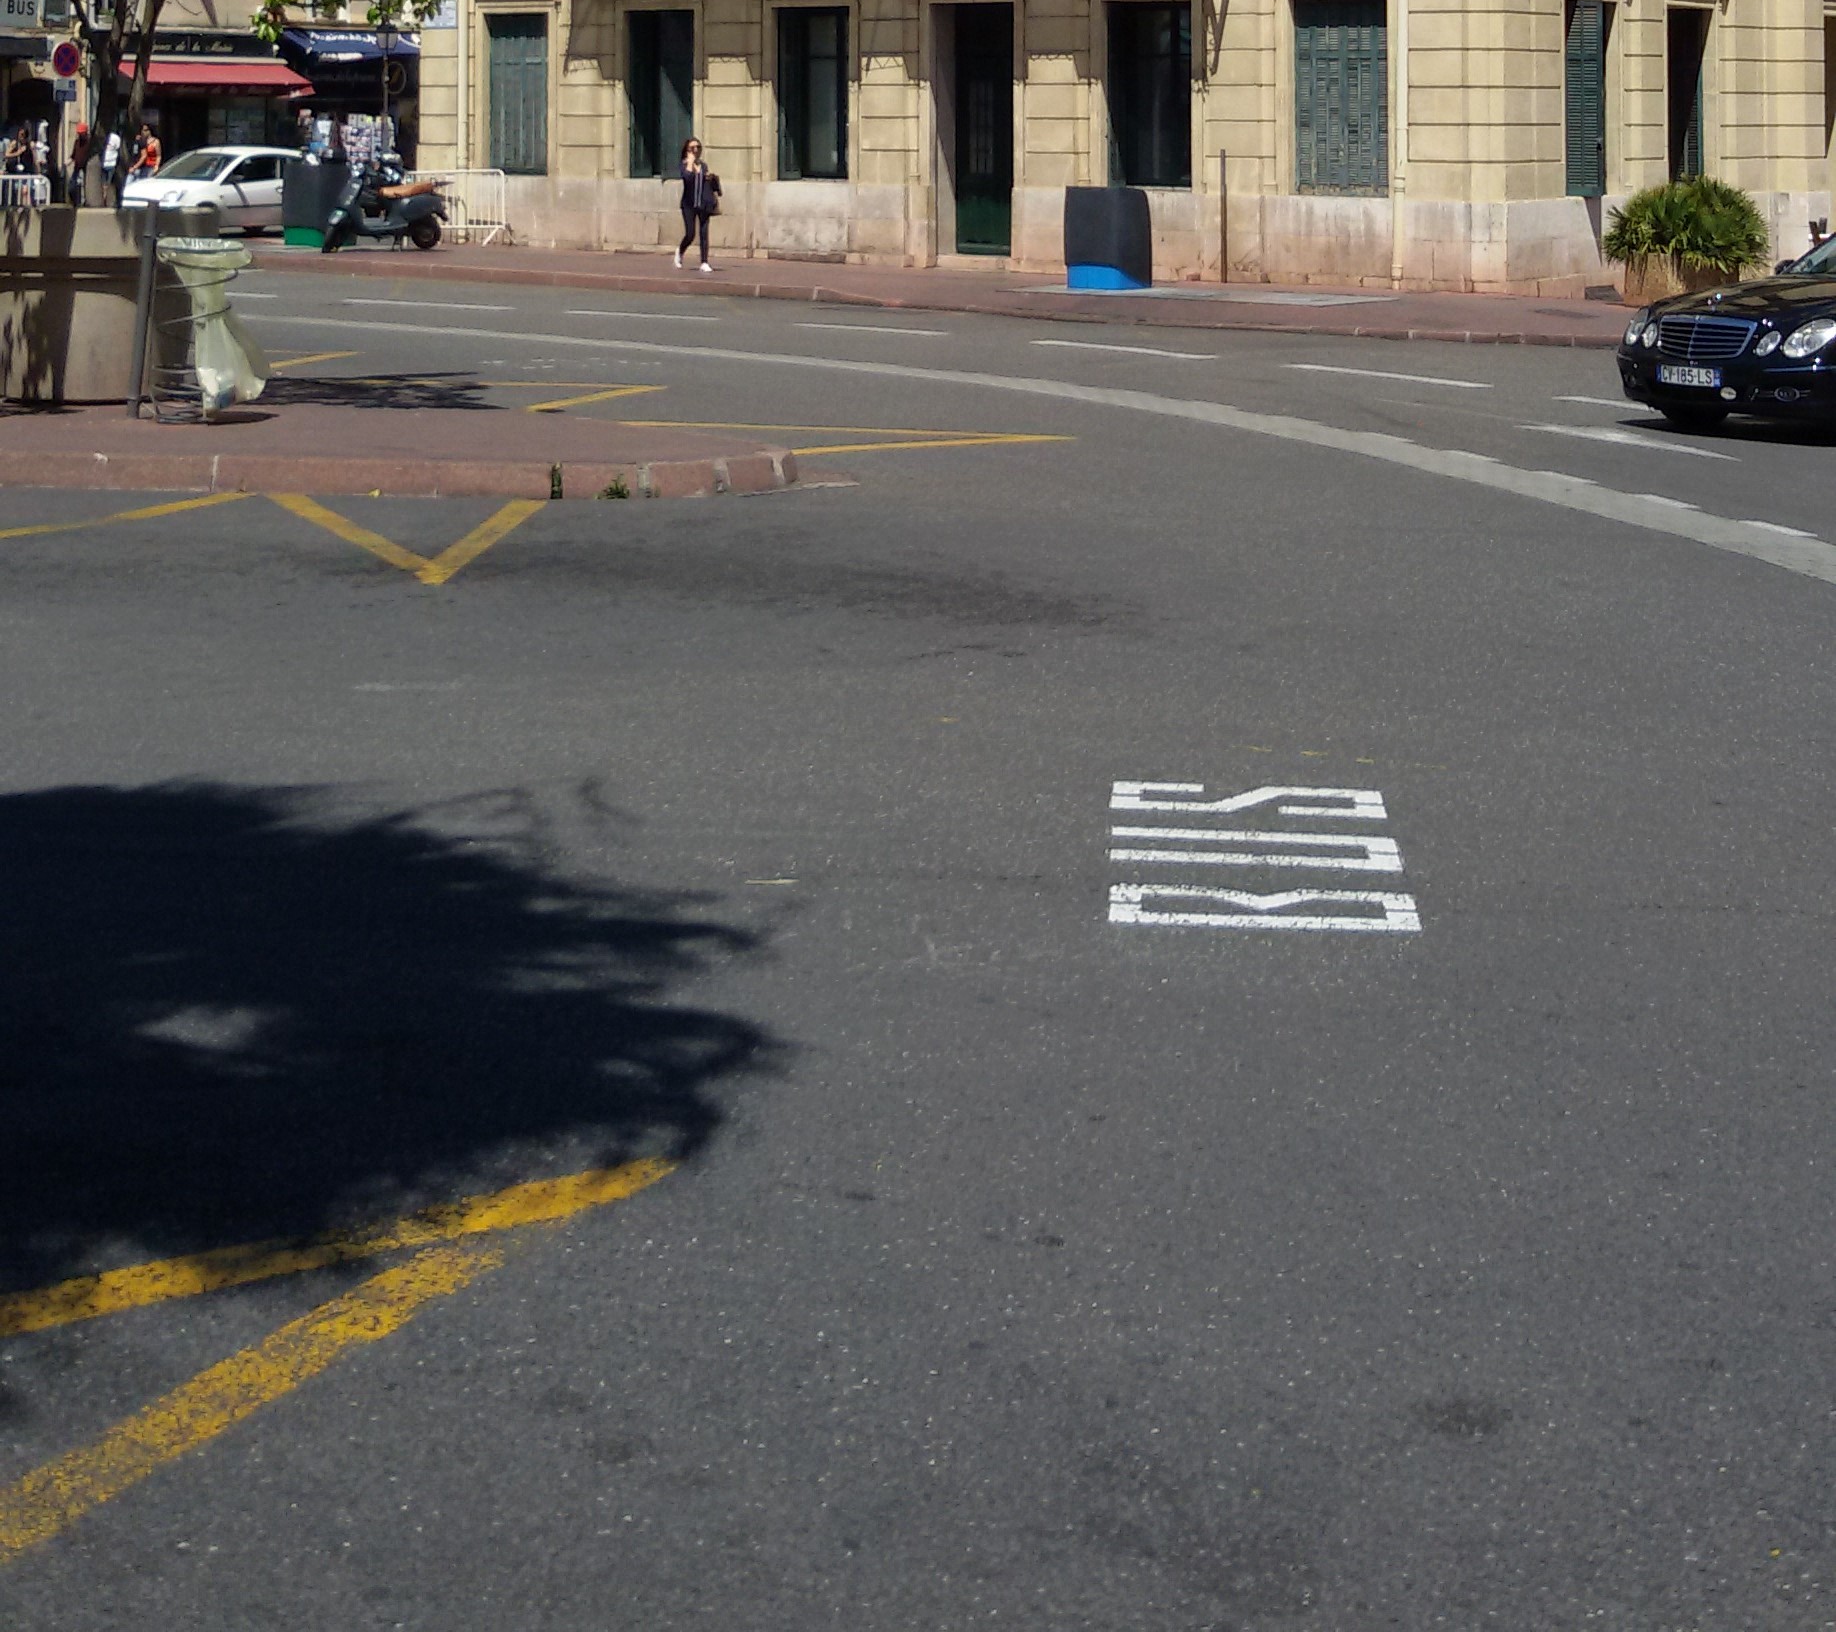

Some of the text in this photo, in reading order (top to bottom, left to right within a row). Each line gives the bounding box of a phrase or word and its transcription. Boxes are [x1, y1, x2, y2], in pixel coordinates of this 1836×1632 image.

[7, 0, 35, 16] BUS
[1662, 366, 1713, 385] CV-185-LS
[1108, 780, 1422, 931] BUS
